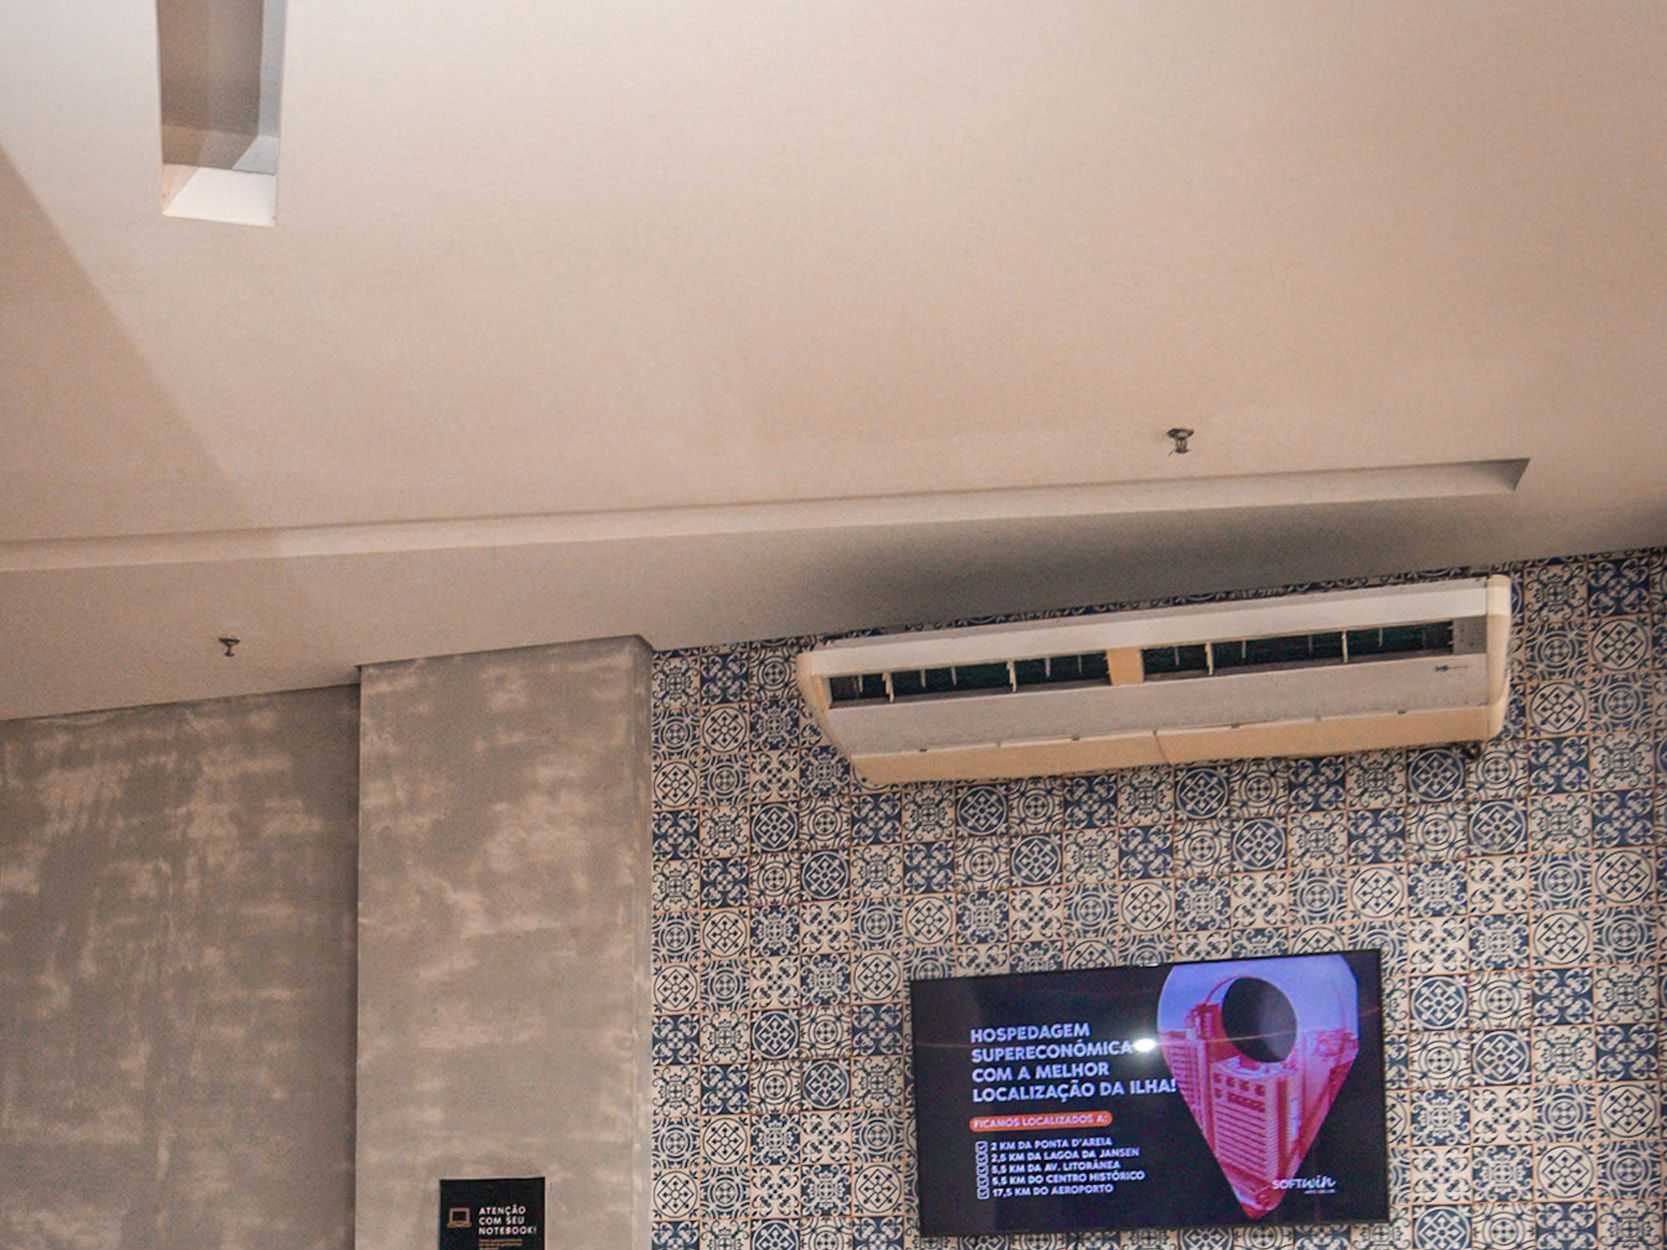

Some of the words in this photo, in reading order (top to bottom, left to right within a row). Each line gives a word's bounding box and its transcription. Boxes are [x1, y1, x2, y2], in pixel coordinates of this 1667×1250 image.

[970, 1022, 1090, 1043] HOSPEDAGEM
[972, 1067, 1013, 1083] COM
[1017, 1066, 1031, 1080] A
[1035, 1062, 1110, 1079] MELHOR
[973, 1080, 1096, 1103] LOCALIZAÇÃO
[1100, 1081, 1125, 1096] DA
[1129, 1078, 1177, 1095] ILHA!
[974, 1117, 1020, 1128] FICAMOS
[1022, 1114, 1094, 1126] LOCALIZADOS
[990, 1142, 998, 1151] 2
[1000, 1141, 1016, 1150] KM
[1018, 1140, 1033, 1150] DA
[1034, 1139, 1069, 1149] PONTA
[991, 1154, 1007, 1163] 2,5
[1009, 1153, 1025, 1162] KM
[1027, 1152, 1042, 1161] DA
[1043, 1150, 1080, 1161] LAGOA
[1081, 1150, 1097, 1159] DA
[1099, 1147, 1140, 1158] JANSEN
[1009, 1164, 1026, 1173] KM
[1027, 1163, 1042, 1172] DA
[1044, 1163, 1061, 1172] AV.
[1009, 1176, 1026, 1185] KM
[1028, 1175, 1044, 1184] DO
[1045, 1173, 1087, 1183] CENTRO
[1089, 1169, 1145, 1181] HISTÓRICO
[992, 1188, 1013, 1198] 17,5
[1014, 1187, 1031, 1196] KM
[1033, 1186, 1049, 1195] DO
[1051, 1183, 1114, 1195] AEROPORTO
[479, 1205, 526, 1216] ATENÇÃO
[478, 1217, 502, 1226] COM
[506, 1216, 525, 1225] SEU
[478, 1226, 537, 1236] NOTEBOOK!
